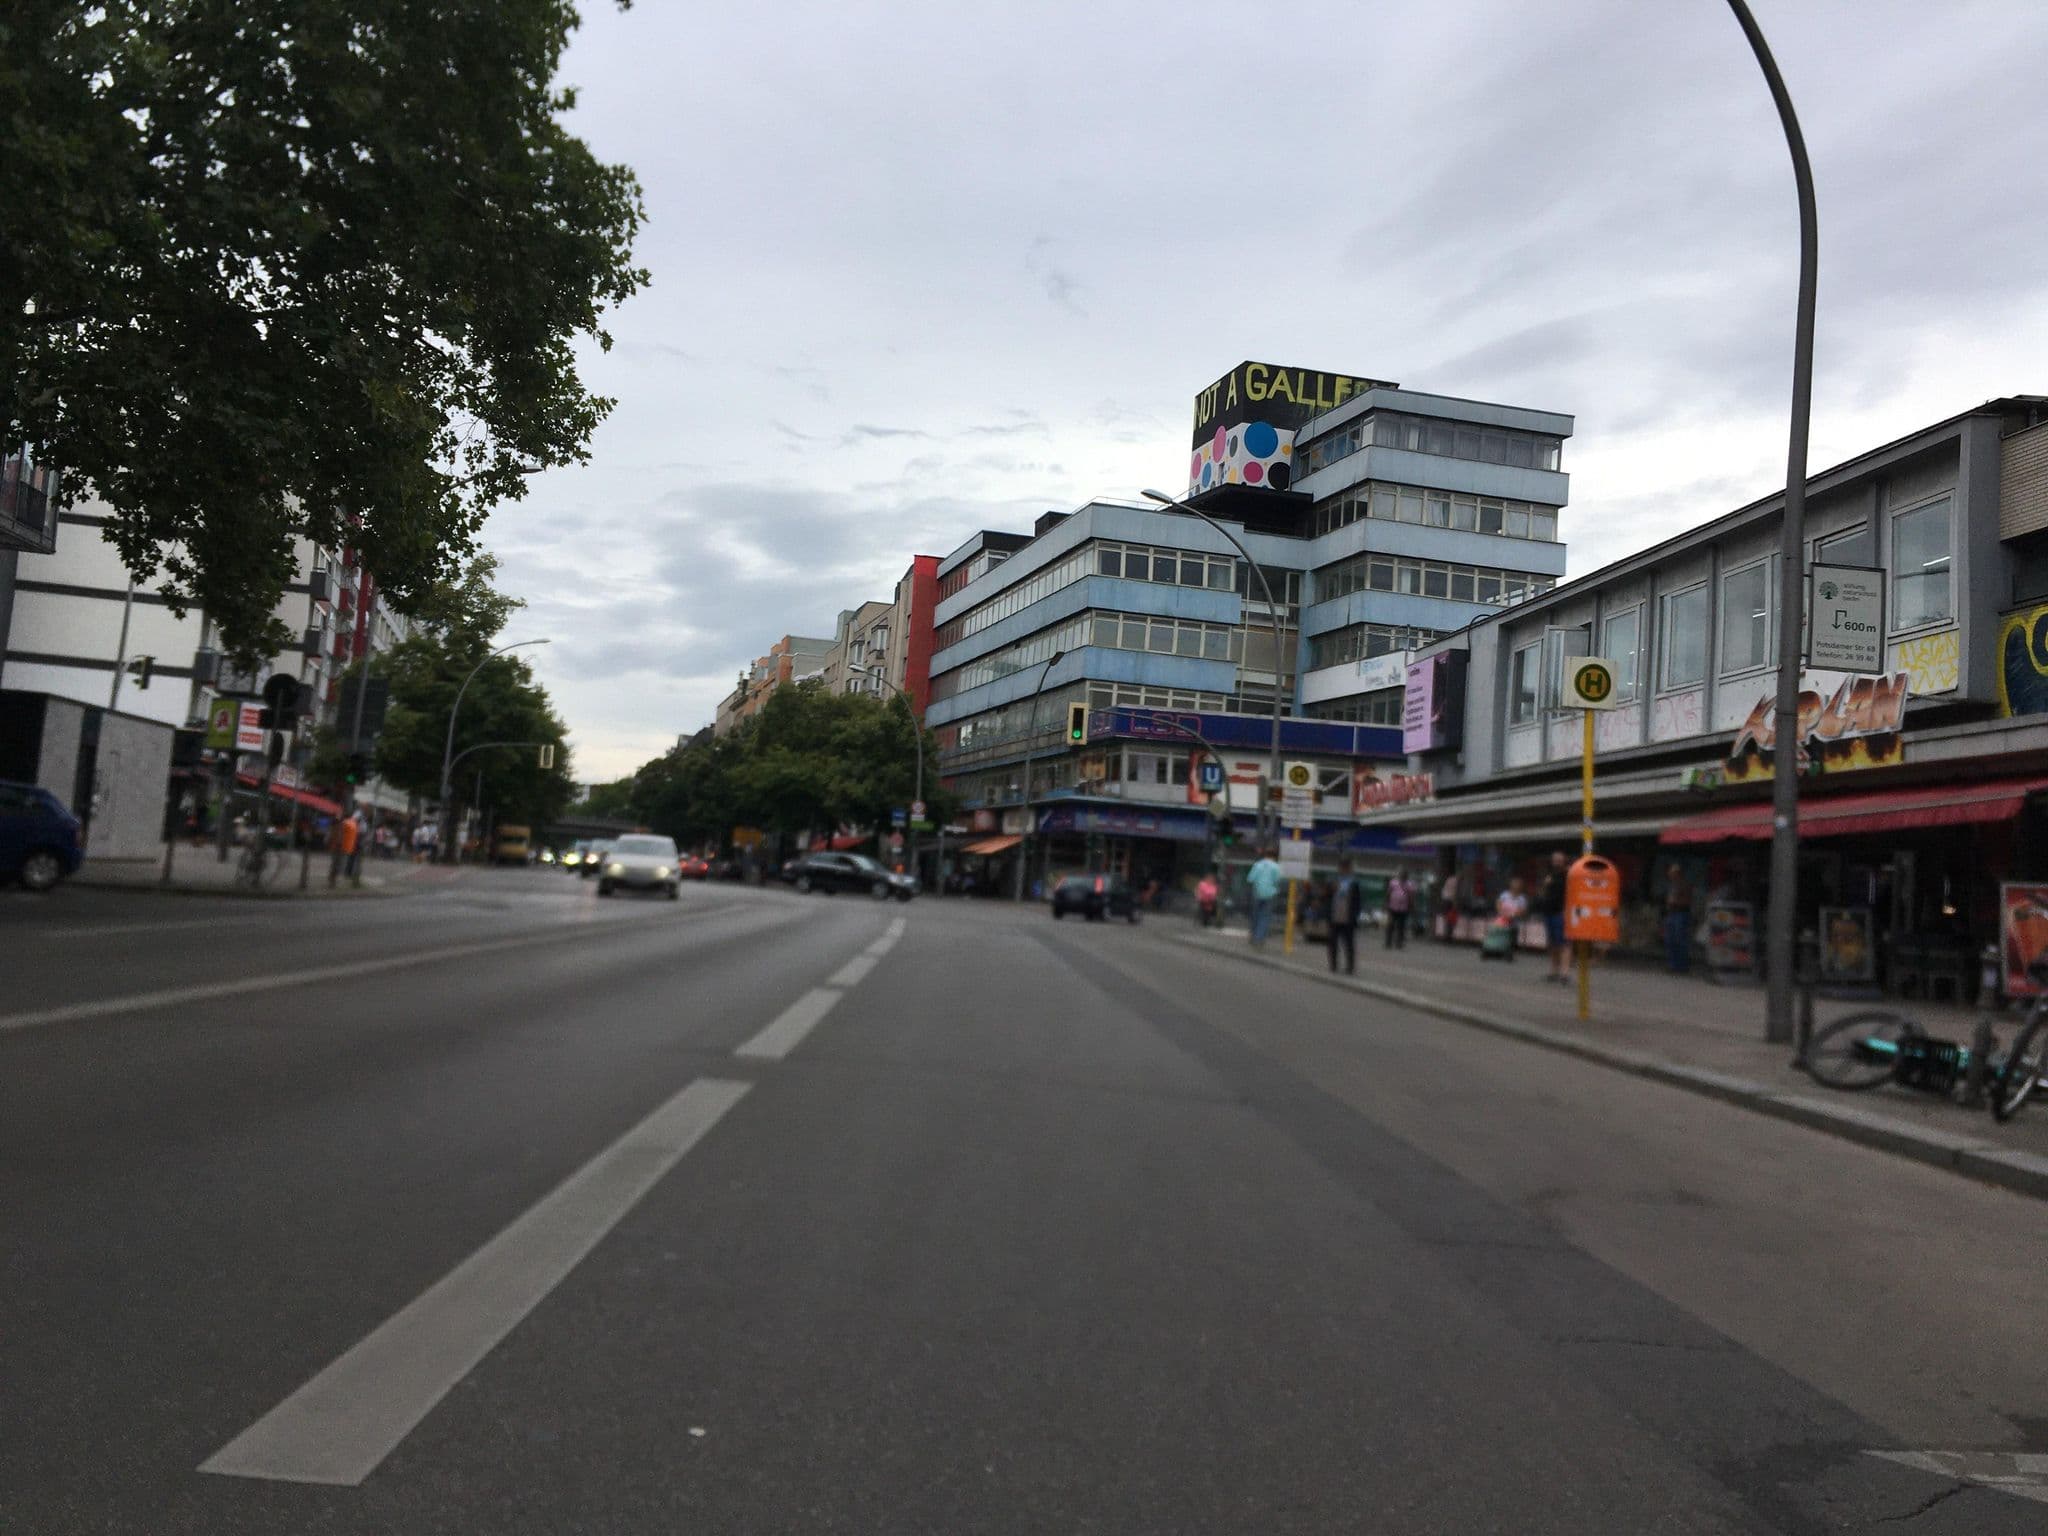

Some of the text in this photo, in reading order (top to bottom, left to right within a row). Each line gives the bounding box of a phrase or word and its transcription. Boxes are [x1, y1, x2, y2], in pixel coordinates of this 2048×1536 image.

[1194, 381, 1222, 430] NOT
[1225, 371, 1238, 411] A
[1844, 621, 1877, 633] 600 m
[1816, 640, 1853, 650] Potsdamer
[1586, 673, 1603, 693] H
[1129, 711, 1203, 737] LSD
[1206, 767, 1219, 783] U
